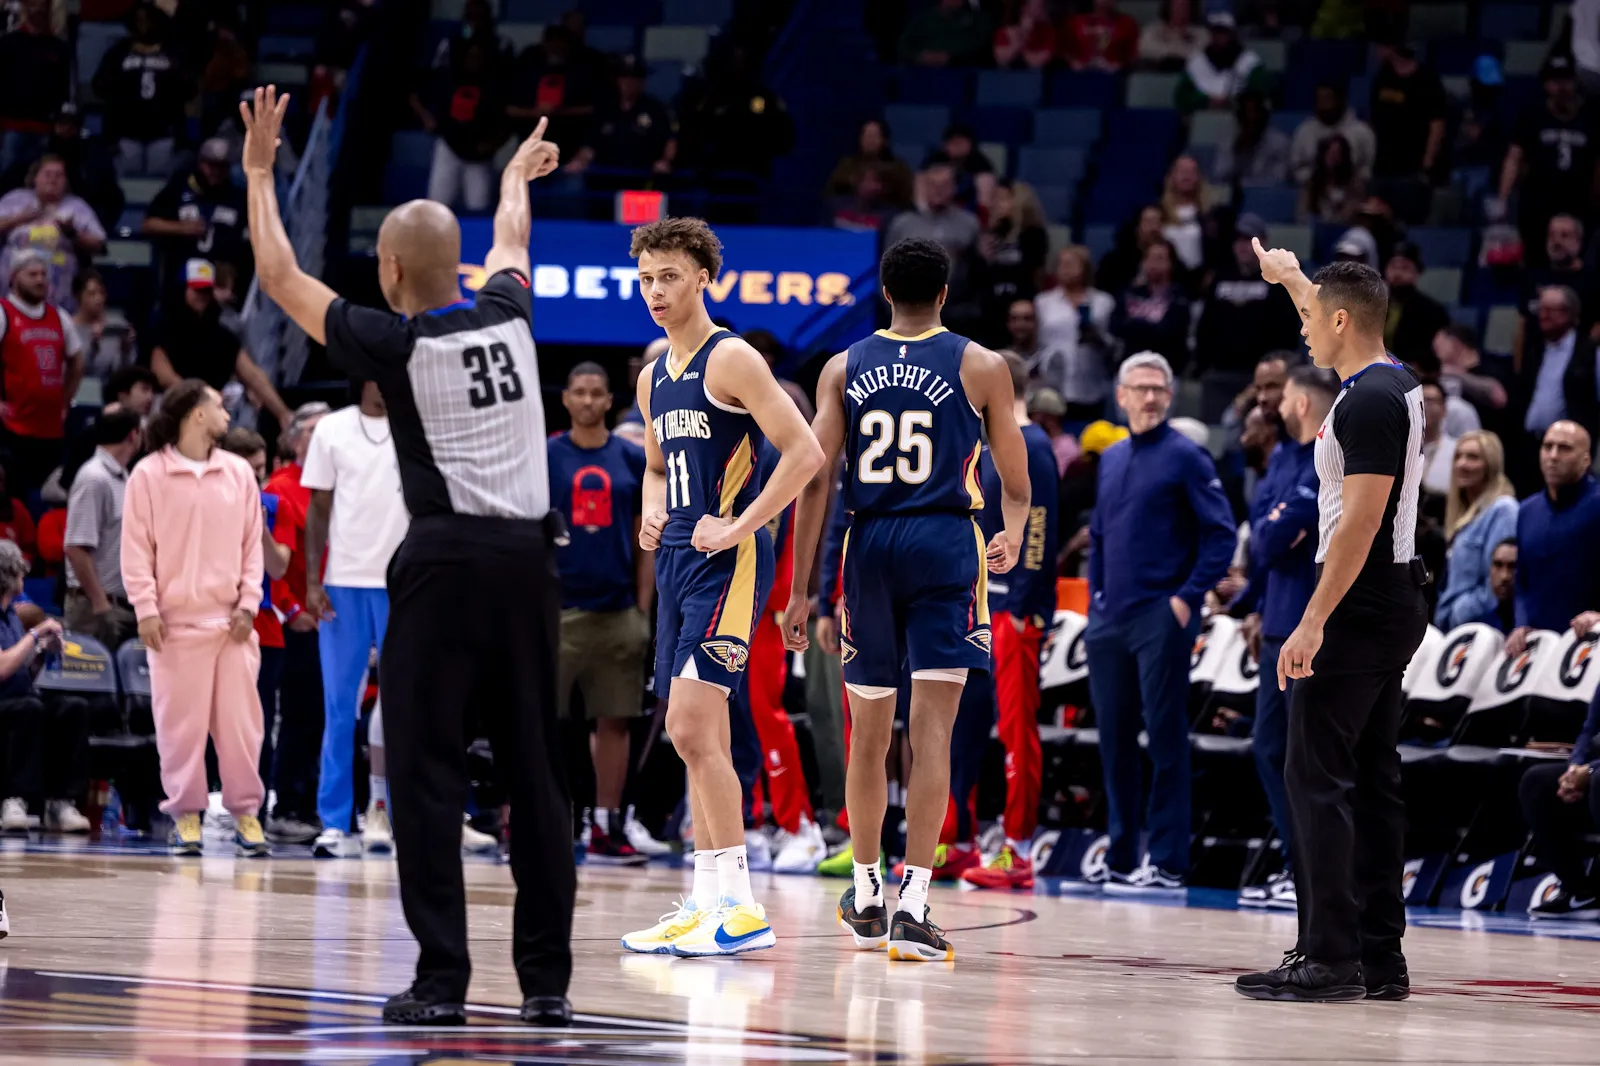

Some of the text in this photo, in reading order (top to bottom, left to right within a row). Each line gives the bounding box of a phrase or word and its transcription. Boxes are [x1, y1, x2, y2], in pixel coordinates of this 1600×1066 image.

[462, 342, 524, 409] 33
[682, 371, 699, 381] ibotta
[846, 363, 954, 407] MURPHY III
[665, 409, 711, 440] ORLEANS
[858, 409, 933, 485] 25
[667, 449, 691, 509] 11
[1024, 506, 1047, 570] PELICANS
[1460, 860, 1495, 908] G
